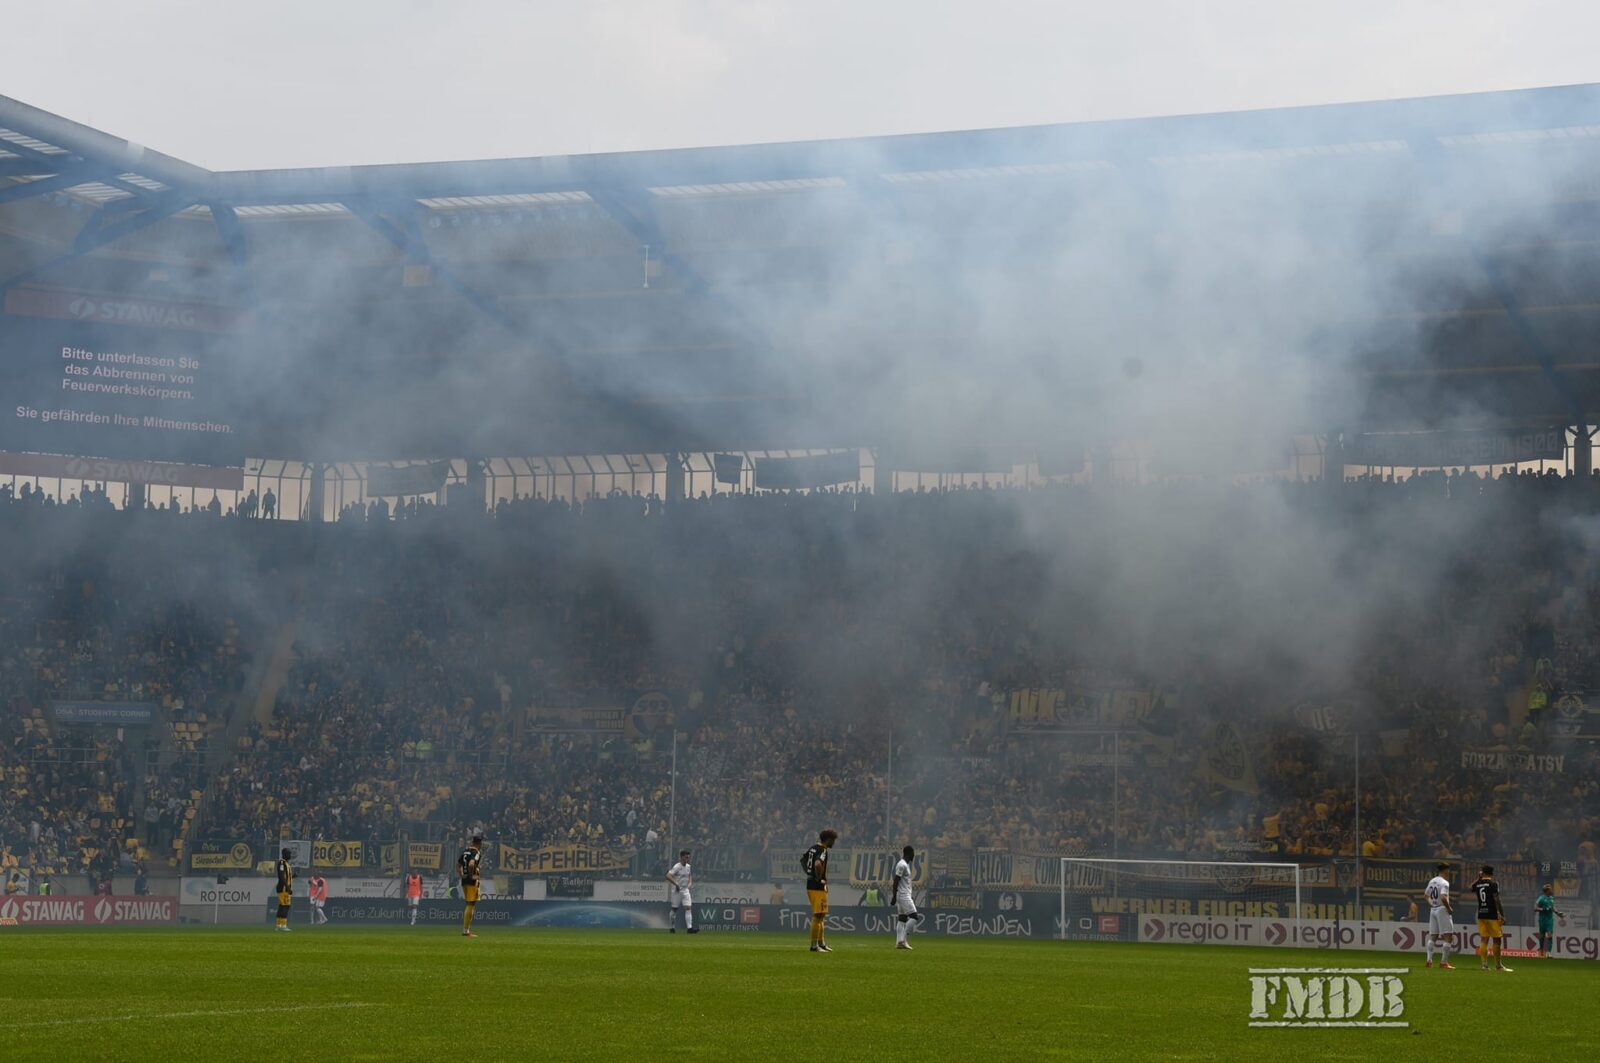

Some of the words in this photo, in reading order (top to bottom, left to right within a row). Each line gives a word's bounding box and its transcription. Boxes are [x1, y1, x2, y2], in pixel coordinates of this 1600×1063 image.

[61, 346, 93, 363] Bitte
[97, 350, 175, 369] unterlassen
[178, 357, 200, 370] Sie
[64, 363, 89, 379] das
[92, 366, 165, 382] Abbrennen
[169, 373, 194, 385] von
[61, 378, 195, 401] Feuerwerkskörpern.
[16, 404, 38, 420] Sie
[41, 408, 110, 424] gefährden
[113, 412, 139, 427] Ihre
[143, 416, 234, 434] Mitmenschen.
[1461, 752, 1505, 769] FORZA
[1527, 755, 1565, 773] ATSV
[313, 845, 328, 861] 20
[348, 845, 362, 861] 15
[854, 852, 925, 881] ULTRS
[199, 889, 250, 903] ROTCOM
[1479, 887, 1487, 903] 6
[22, 901, 84, 921] STAWAG
[114, 902, 170, 920] STAWAG
[331, 906, 348, 918] Für
[350, 906, 364, 918] die
[367, 907, 405, 919] Zukunft
[1091, 897, 1192, 915] WERNER
[1198, 900, 1280, 918] FUCHS
[864, 913, 928, 933] UNTR
[936, 913, 1031, 936] FREUNDEN
[1168, 918, 1229, 945] regio
